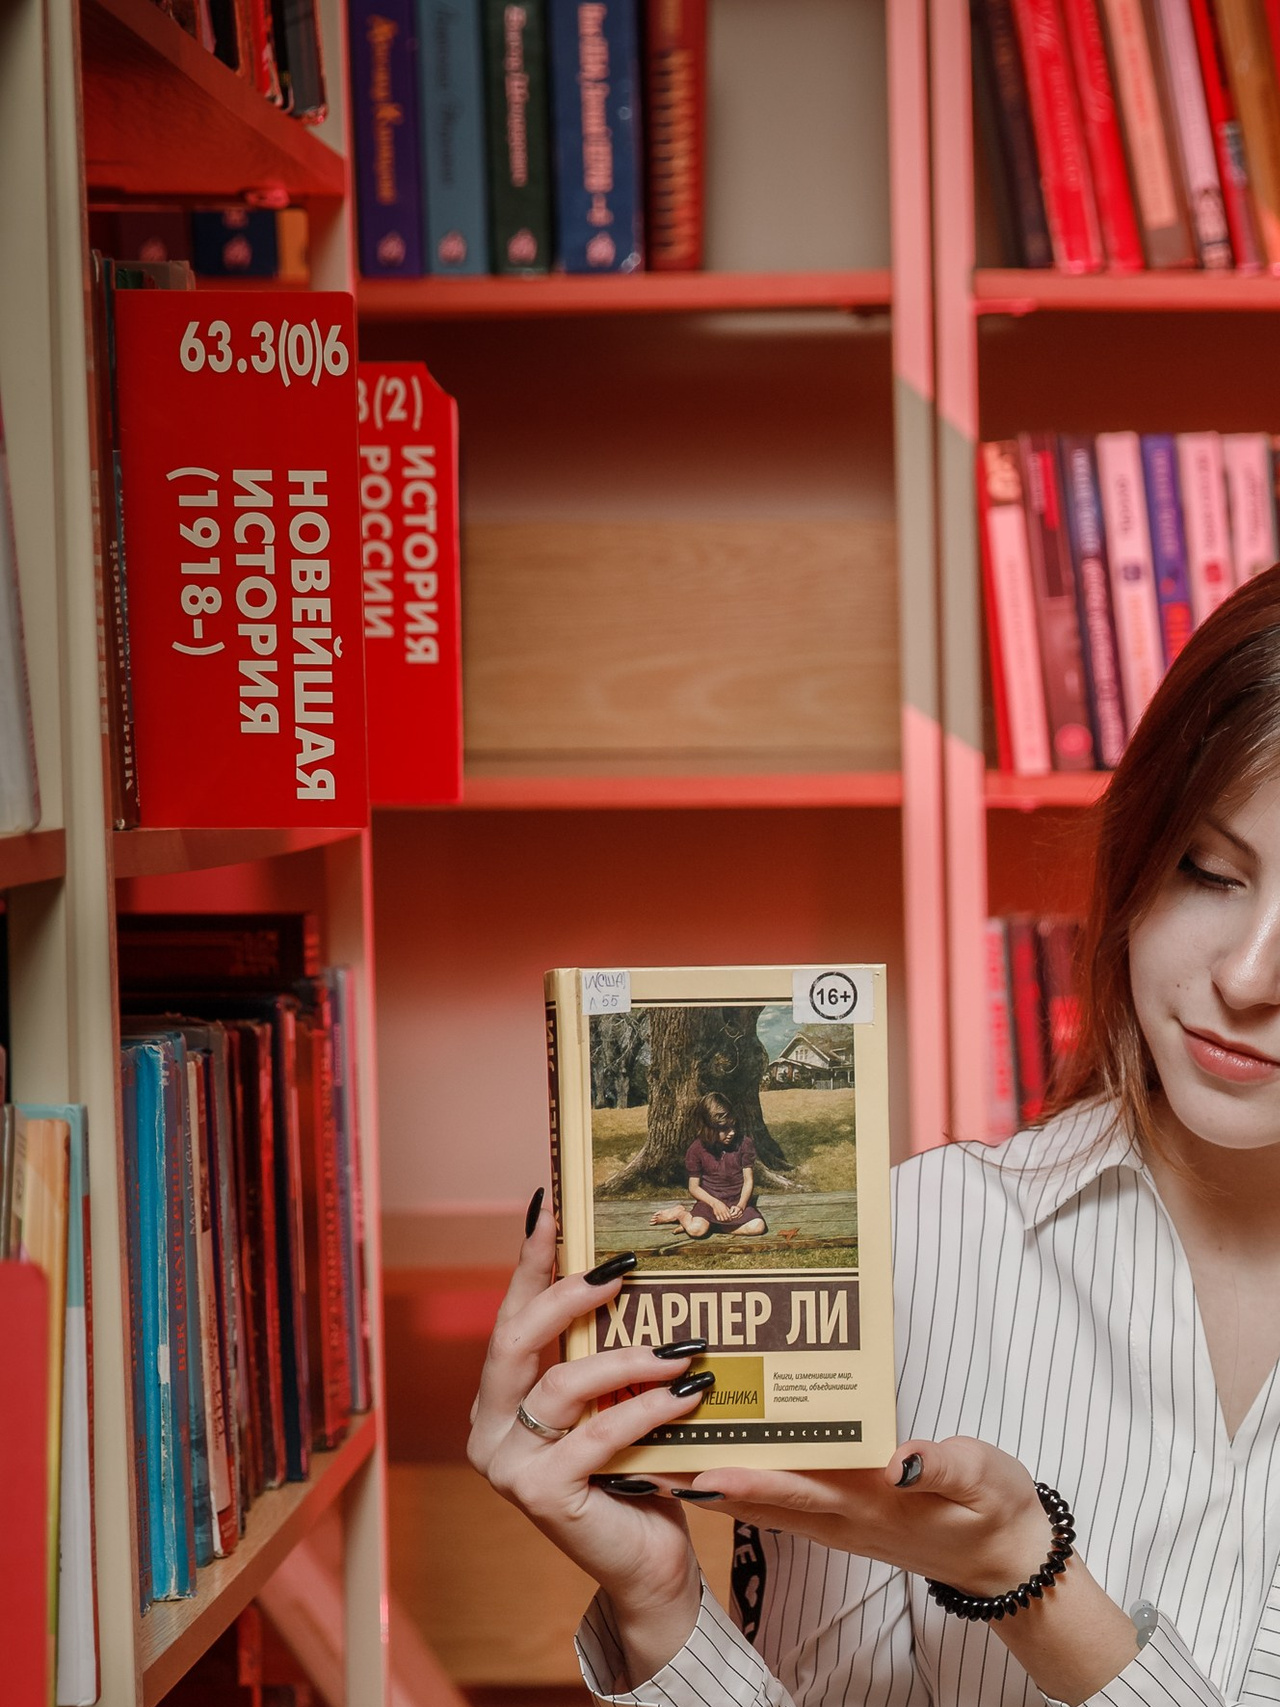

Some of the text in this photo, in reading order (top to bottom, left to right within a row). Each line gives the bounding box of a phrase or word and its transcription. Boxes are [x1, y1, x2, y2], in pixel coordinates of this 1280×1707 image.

[180, 319, 349, 387] 63.3(0)6
[358, 375, 423, 431] 3(2)
[166, 466, 225, 656] (1918-)
[359, 446, 394, 639] РОССИИ
[402, 446, 439, 664] ИСТОРИЯ
[232, 469, 280, 735] ИСТОРИЯ
[287, 469, 343, 801] НОВЕЙШАЯ
[602, 994, 619, 1007] 55
[816, 987, 852, 1007] 16+
[604, 1290, 848, 1348] ХАРПЕР ЛИ
[176, 1322, 186, 1372] ВЕК
[701, 1390, 758, 1405] МЕШНИКА
[773, 1372, 853, 1381] Книги, изменившие мир.
[773, 1382, 858, 1392] Писатели, объединившие
[773, 1395, 810, 1403] поколения.
[653, 1429, 856, 1439] люзивная классика
